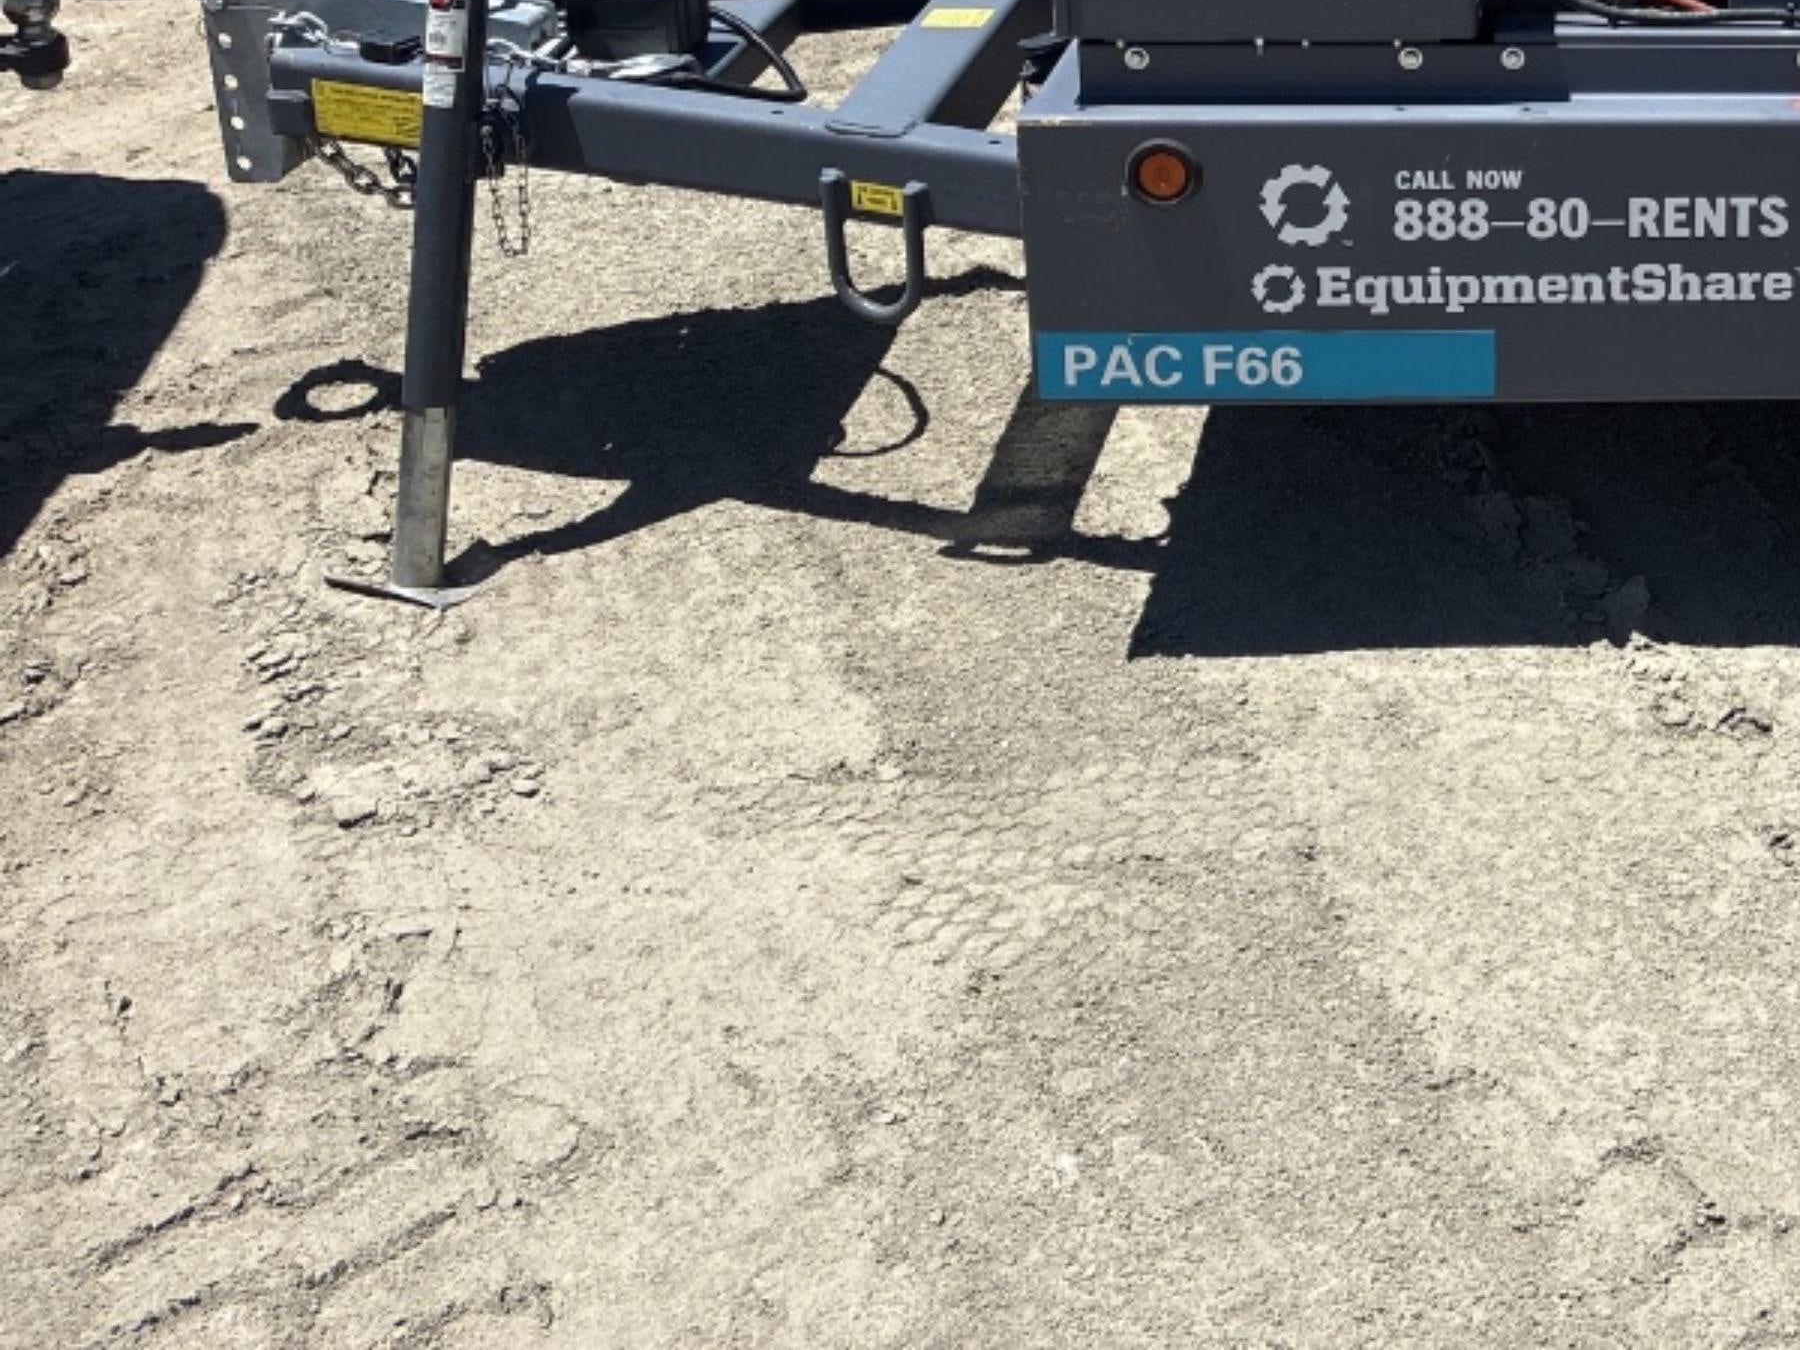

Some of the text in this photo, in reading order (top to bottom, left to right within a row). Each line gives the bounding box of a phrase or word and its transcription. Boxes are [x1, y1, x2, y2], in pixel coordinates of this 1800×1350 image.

[1394, 170, 1523, 190] CALL NOW
[1315, 263, 1794, 315] EquipmentShare
[1063, 344, 1304, 388] PAC F66
